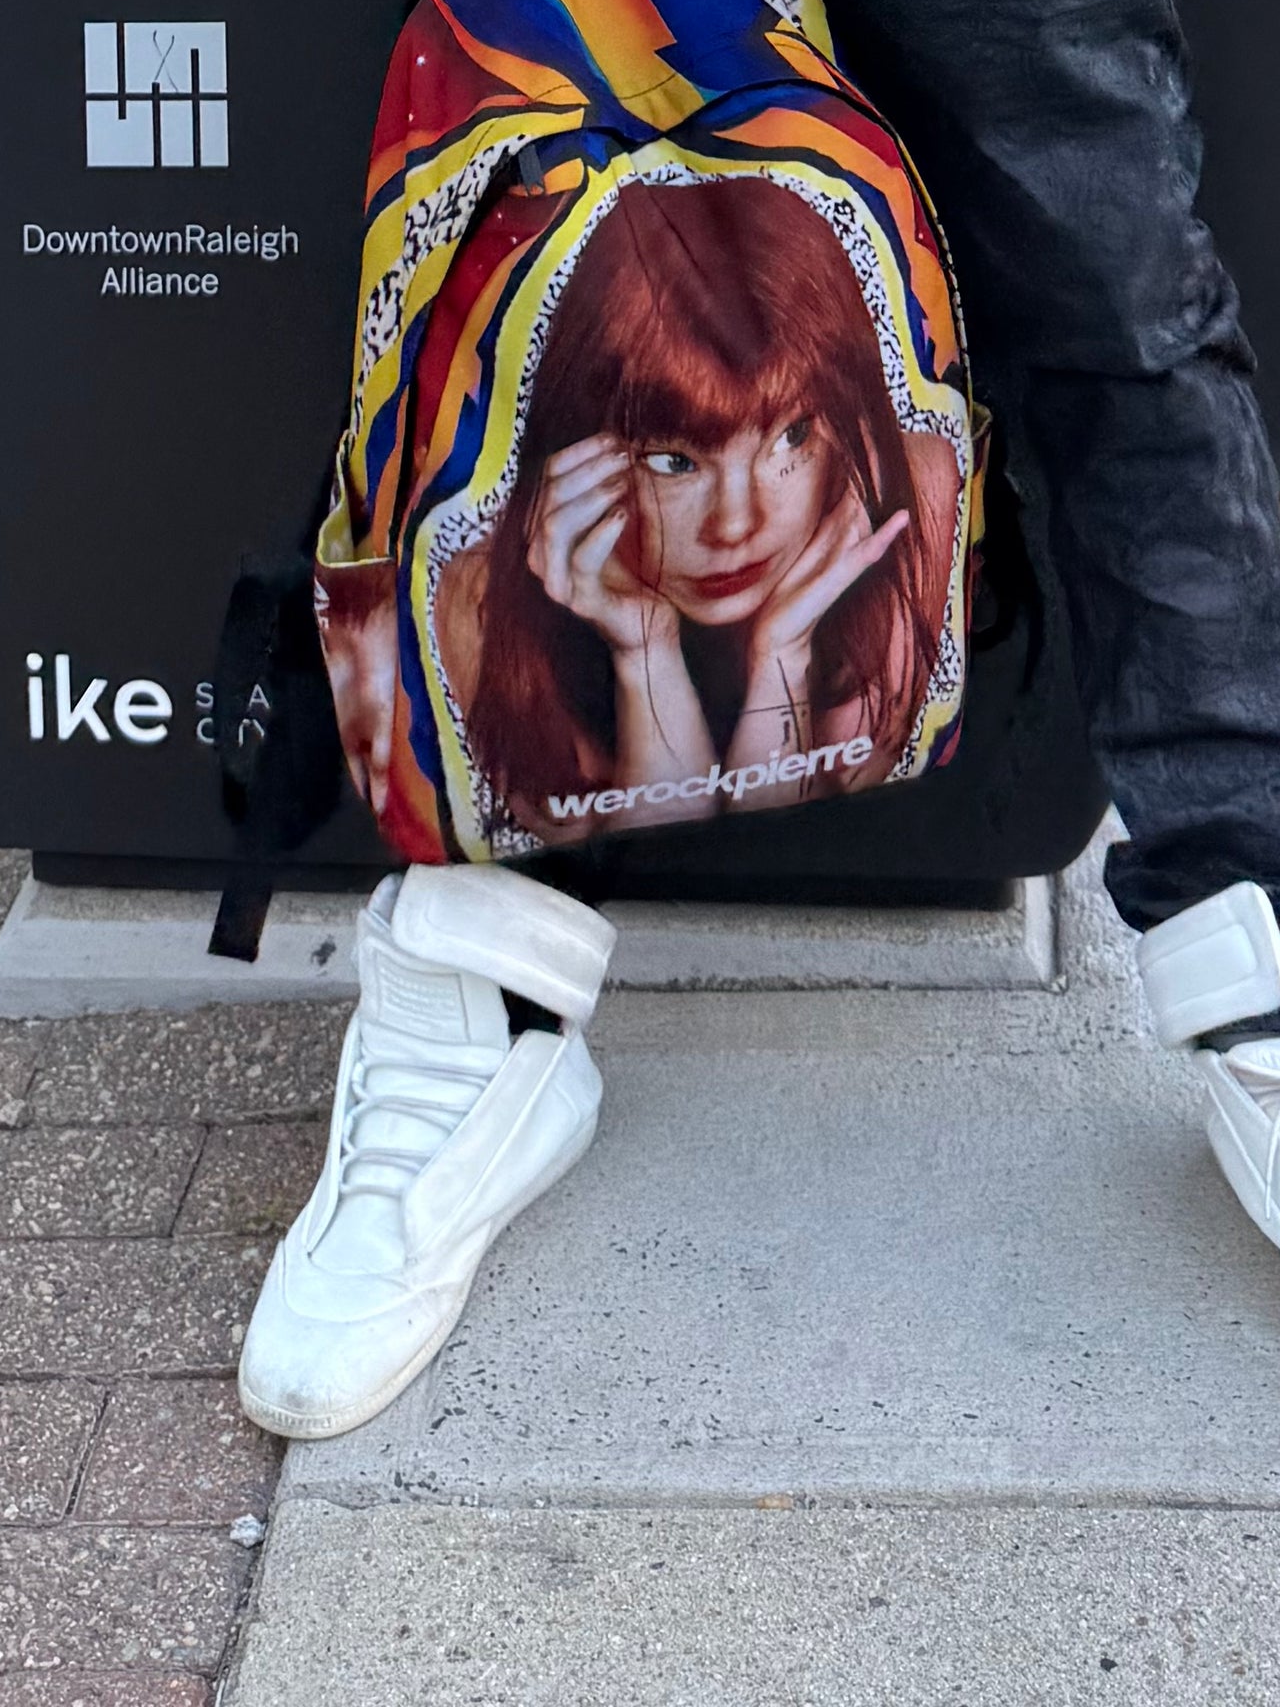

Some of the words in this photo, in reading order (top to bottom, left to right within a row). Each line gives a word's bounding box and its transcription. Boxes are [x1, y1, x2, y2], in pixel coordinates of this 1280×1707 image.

[22, 223, 299, 261] DowntownRaleigh
[100, 266, 219, 296] Alliance
[25, 651, 174, 746] ike
[547, 735, 873, 812] werockpierre
